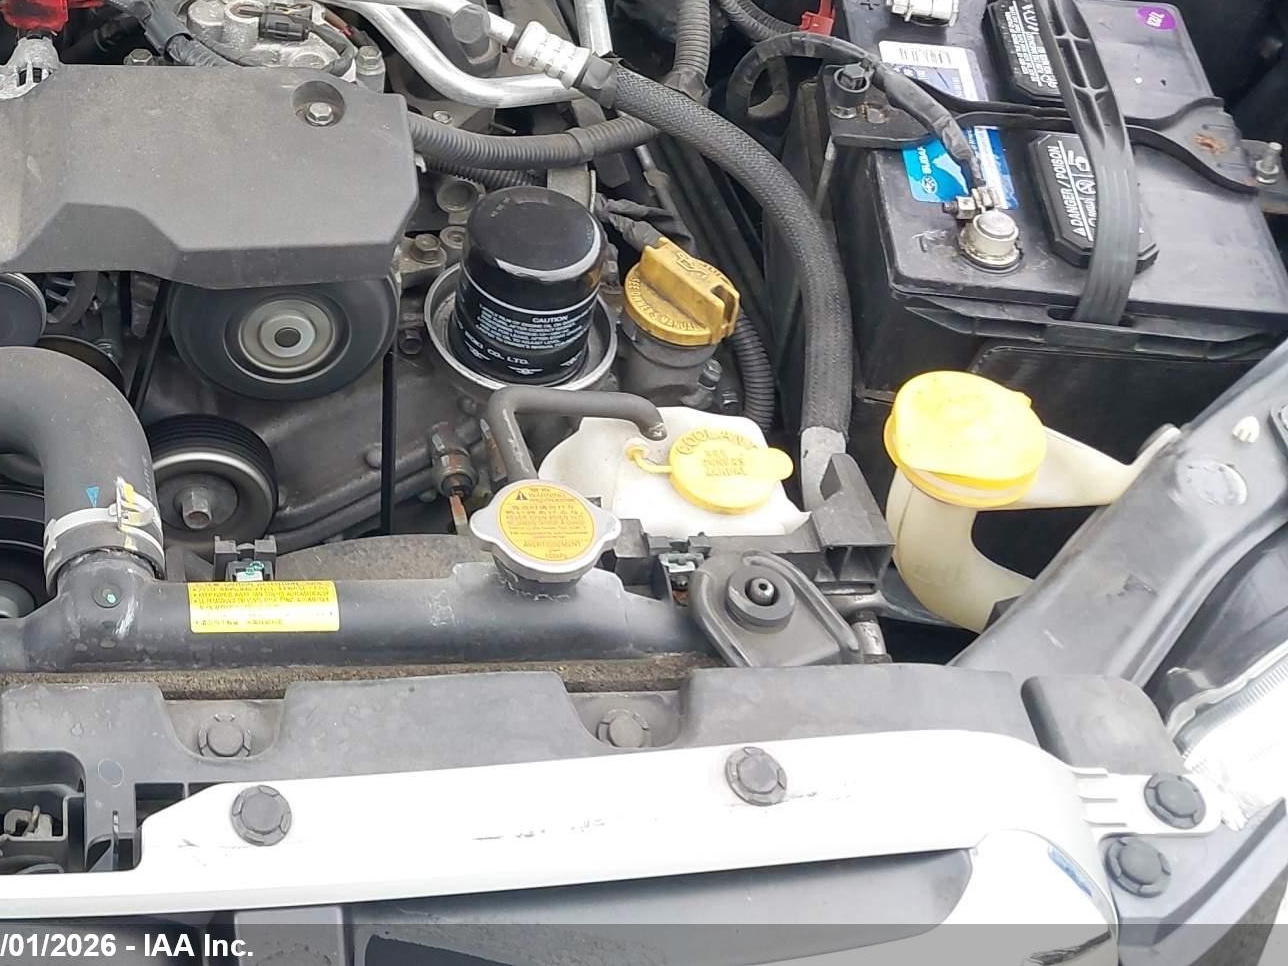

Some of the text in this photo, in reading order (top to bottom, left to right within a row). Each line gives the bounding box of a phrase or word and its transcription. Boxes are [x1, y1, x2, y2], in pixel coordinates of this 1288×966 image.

[1047, 145, 1068, 180] POISON
[1060, 188, 1083, 227] DANGER
[532, 314, 569, 324] CAUTION
[676, 428, 758, 455] COOLANT
